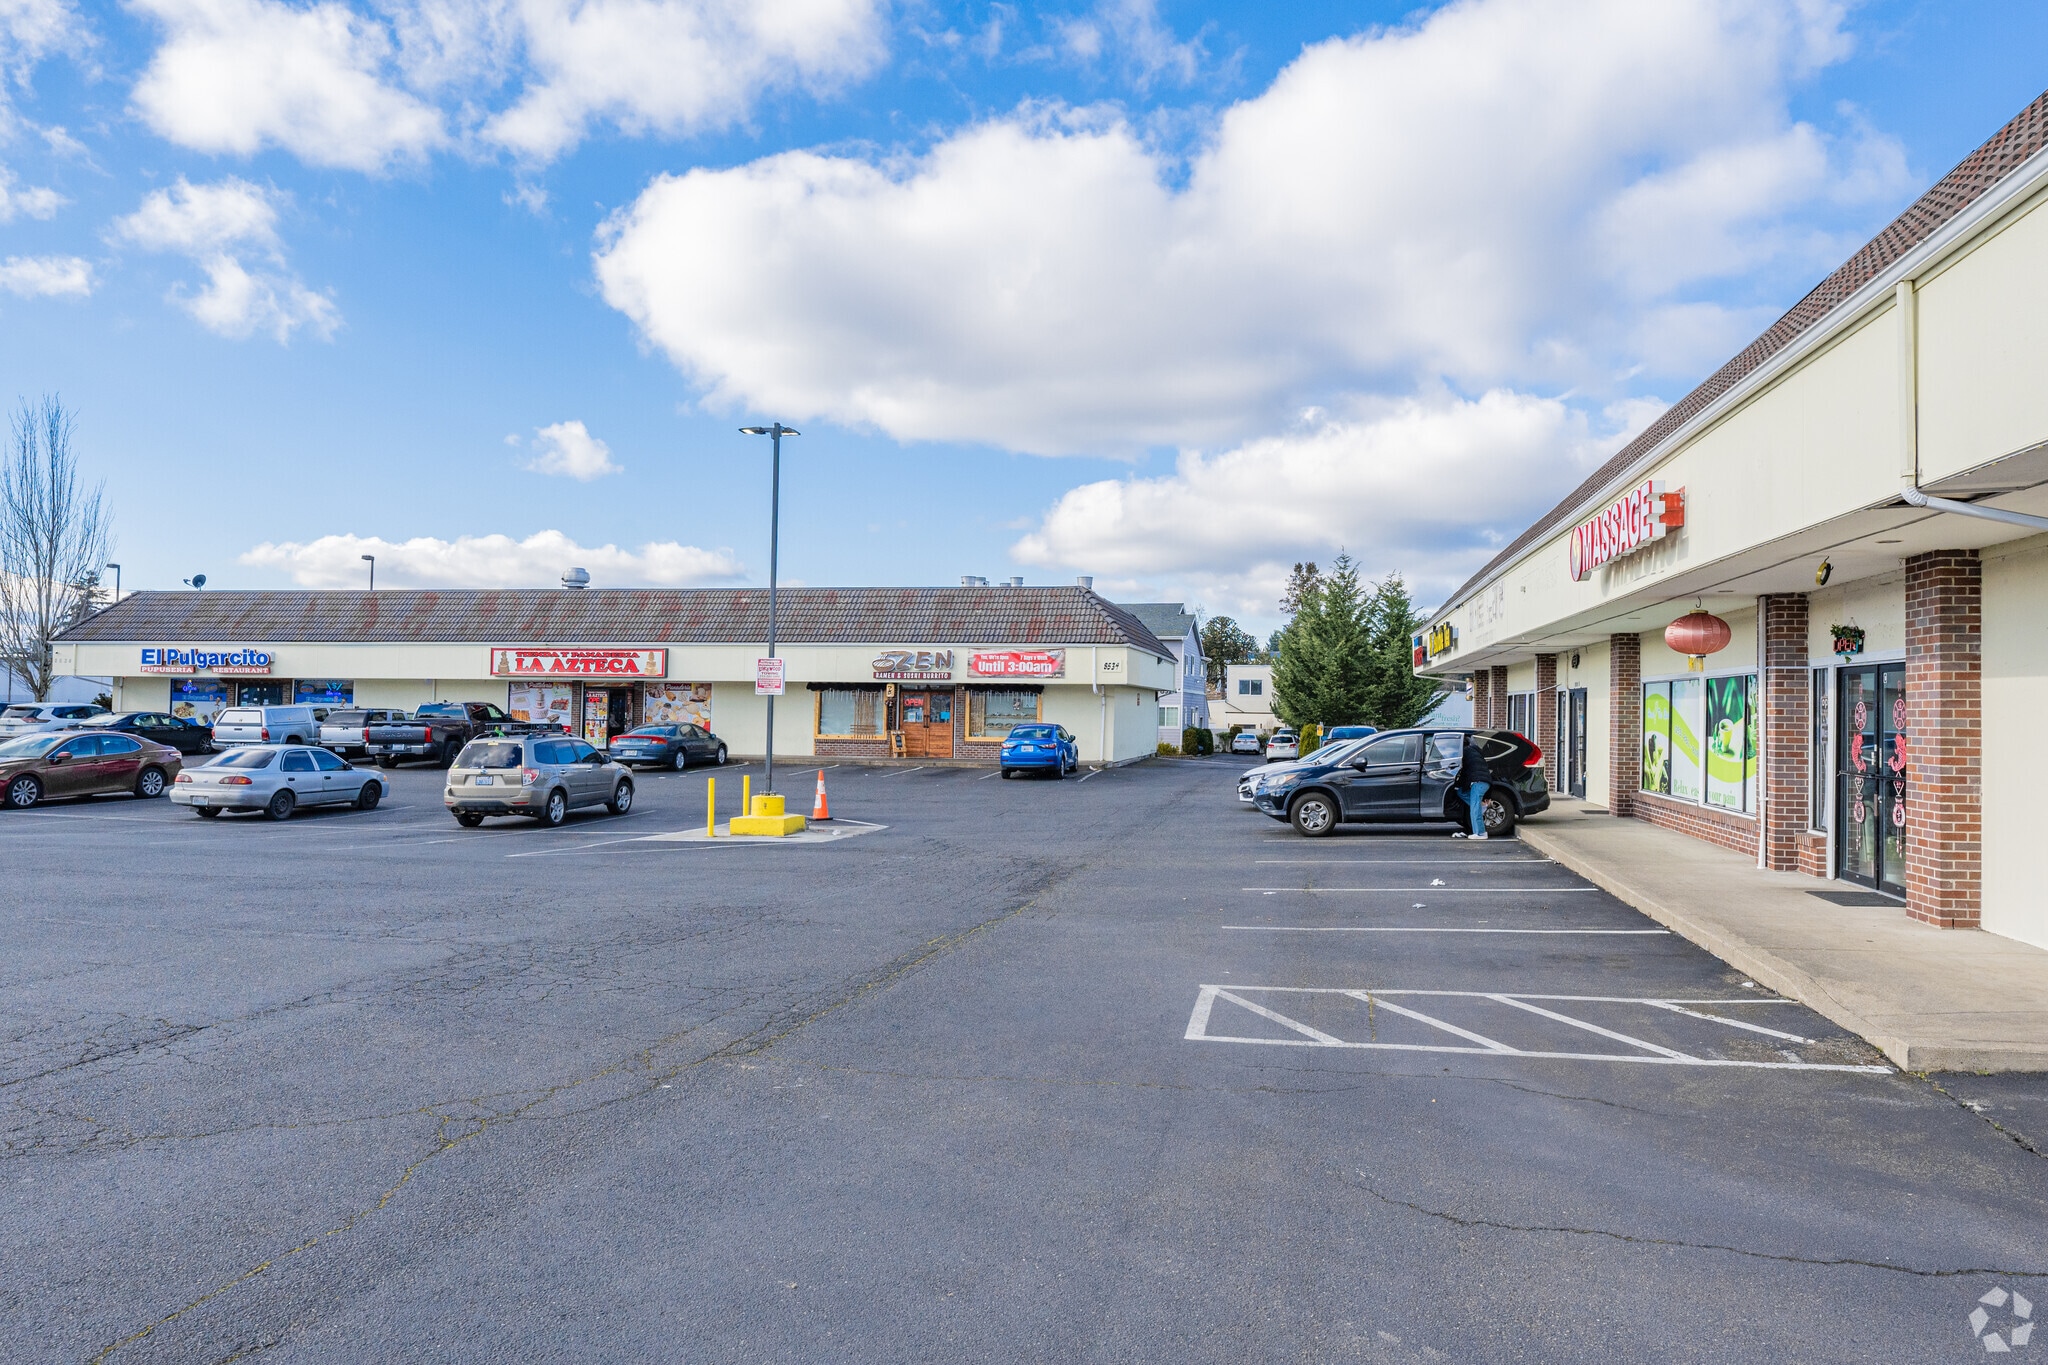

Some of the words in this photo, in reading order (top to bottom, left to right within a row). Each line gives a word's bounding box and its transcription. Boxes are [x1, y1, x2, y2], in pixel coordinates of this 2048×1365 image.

[1582, 481, 1652, 572] MASSAGE
[141, 649, 161, 665] El
[167, 649, 269, 669] Pulgarcito
[515, 658, 545, 672] LA
[549, 658, 640, 673] AZTECA
[882, 650, 952, 671] ZEN
[978, 661, 1005, 672] Until
[1008, 661, 1052, 673] 3:00am
[904, 698, 924, 707] OPEN
